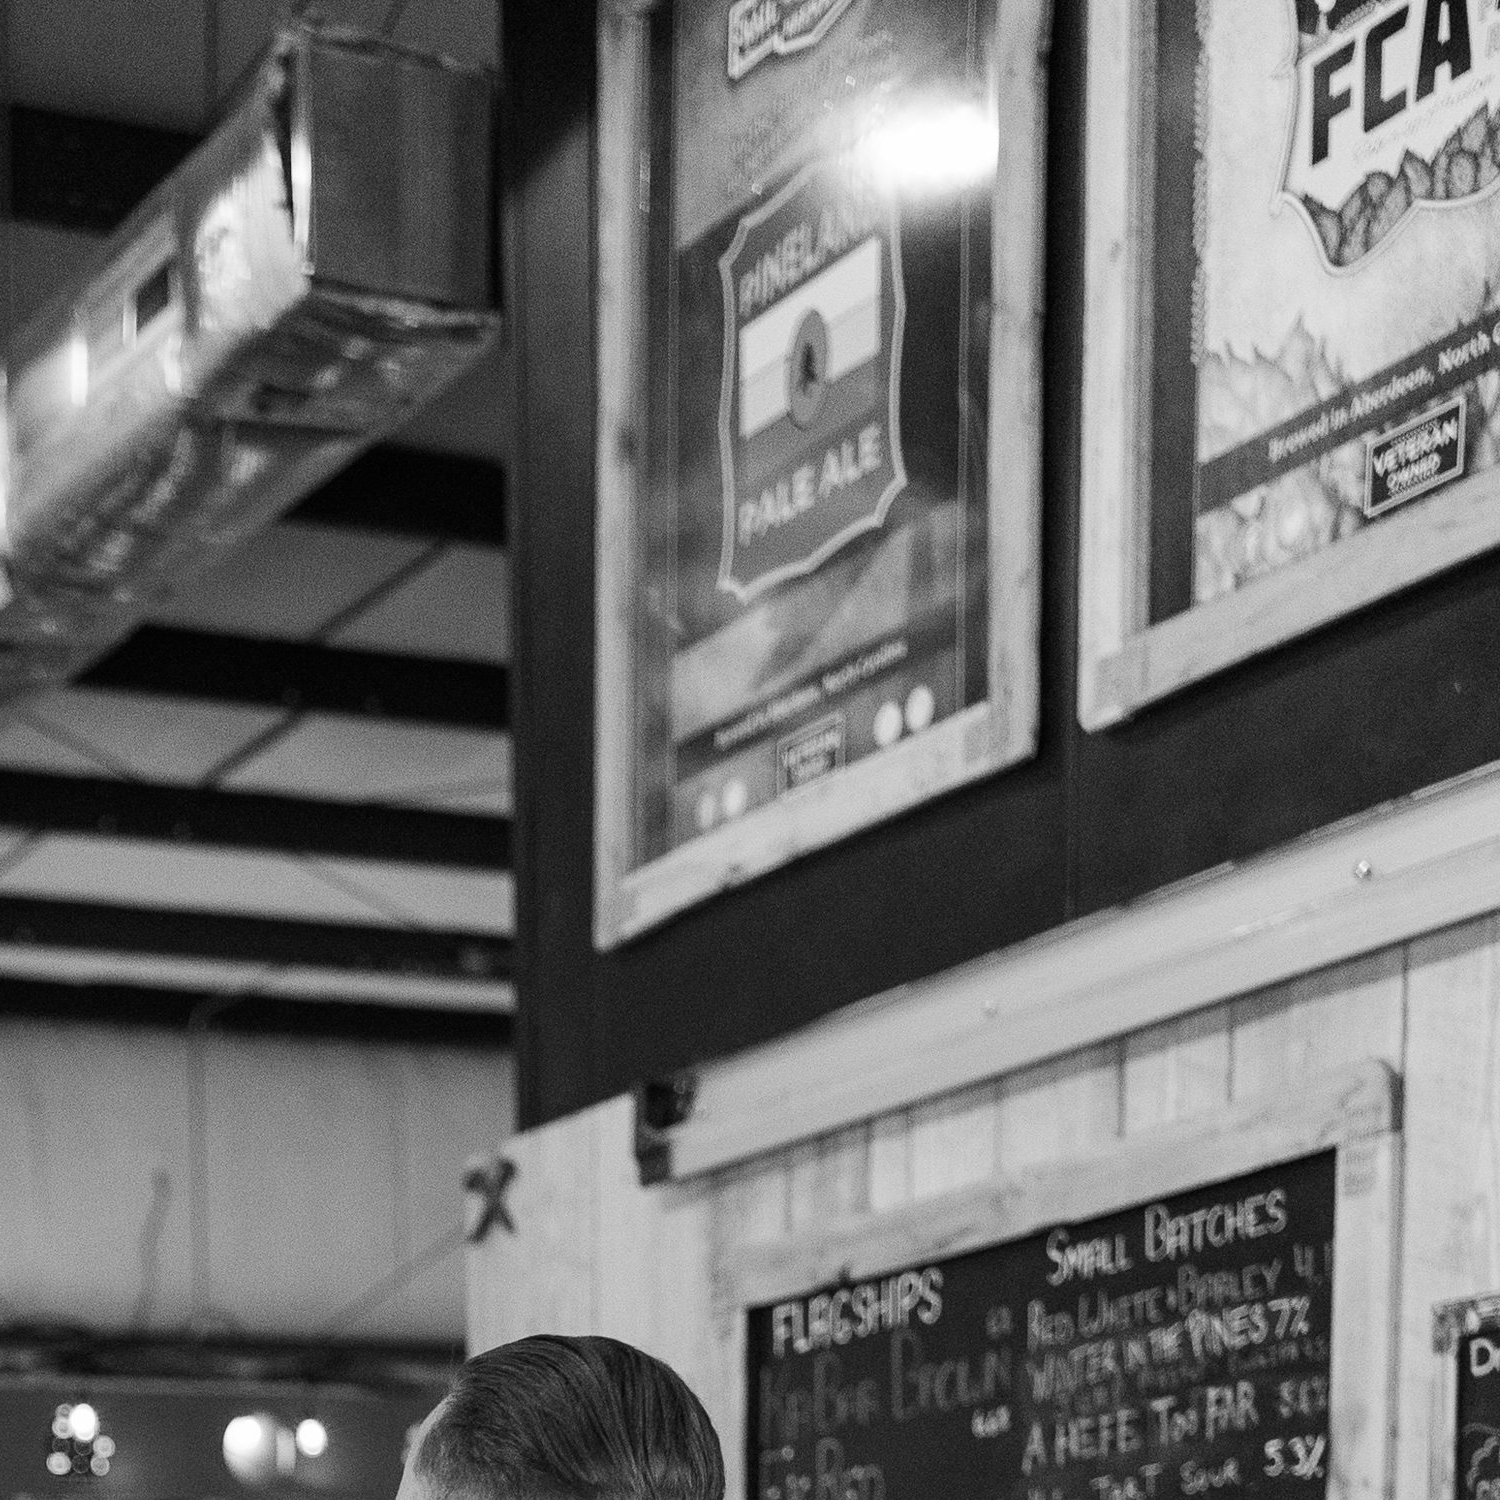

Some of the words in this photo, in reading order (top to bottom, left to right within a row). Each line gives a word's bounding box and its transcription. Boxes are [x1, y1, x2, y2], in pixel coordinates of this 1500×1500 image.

[1310, 0, 1471, 166] FCA
[1438, 330, 1490, 374] North
[739, 464, 816, 548] PALE
[819, 422, 882, 498] ALE
[1373, 417, 1457, 477] VETERAN
[772, 1266, 944, 1359] FLAGSHIPS
[1021, 1421, 1048, 1477] A
